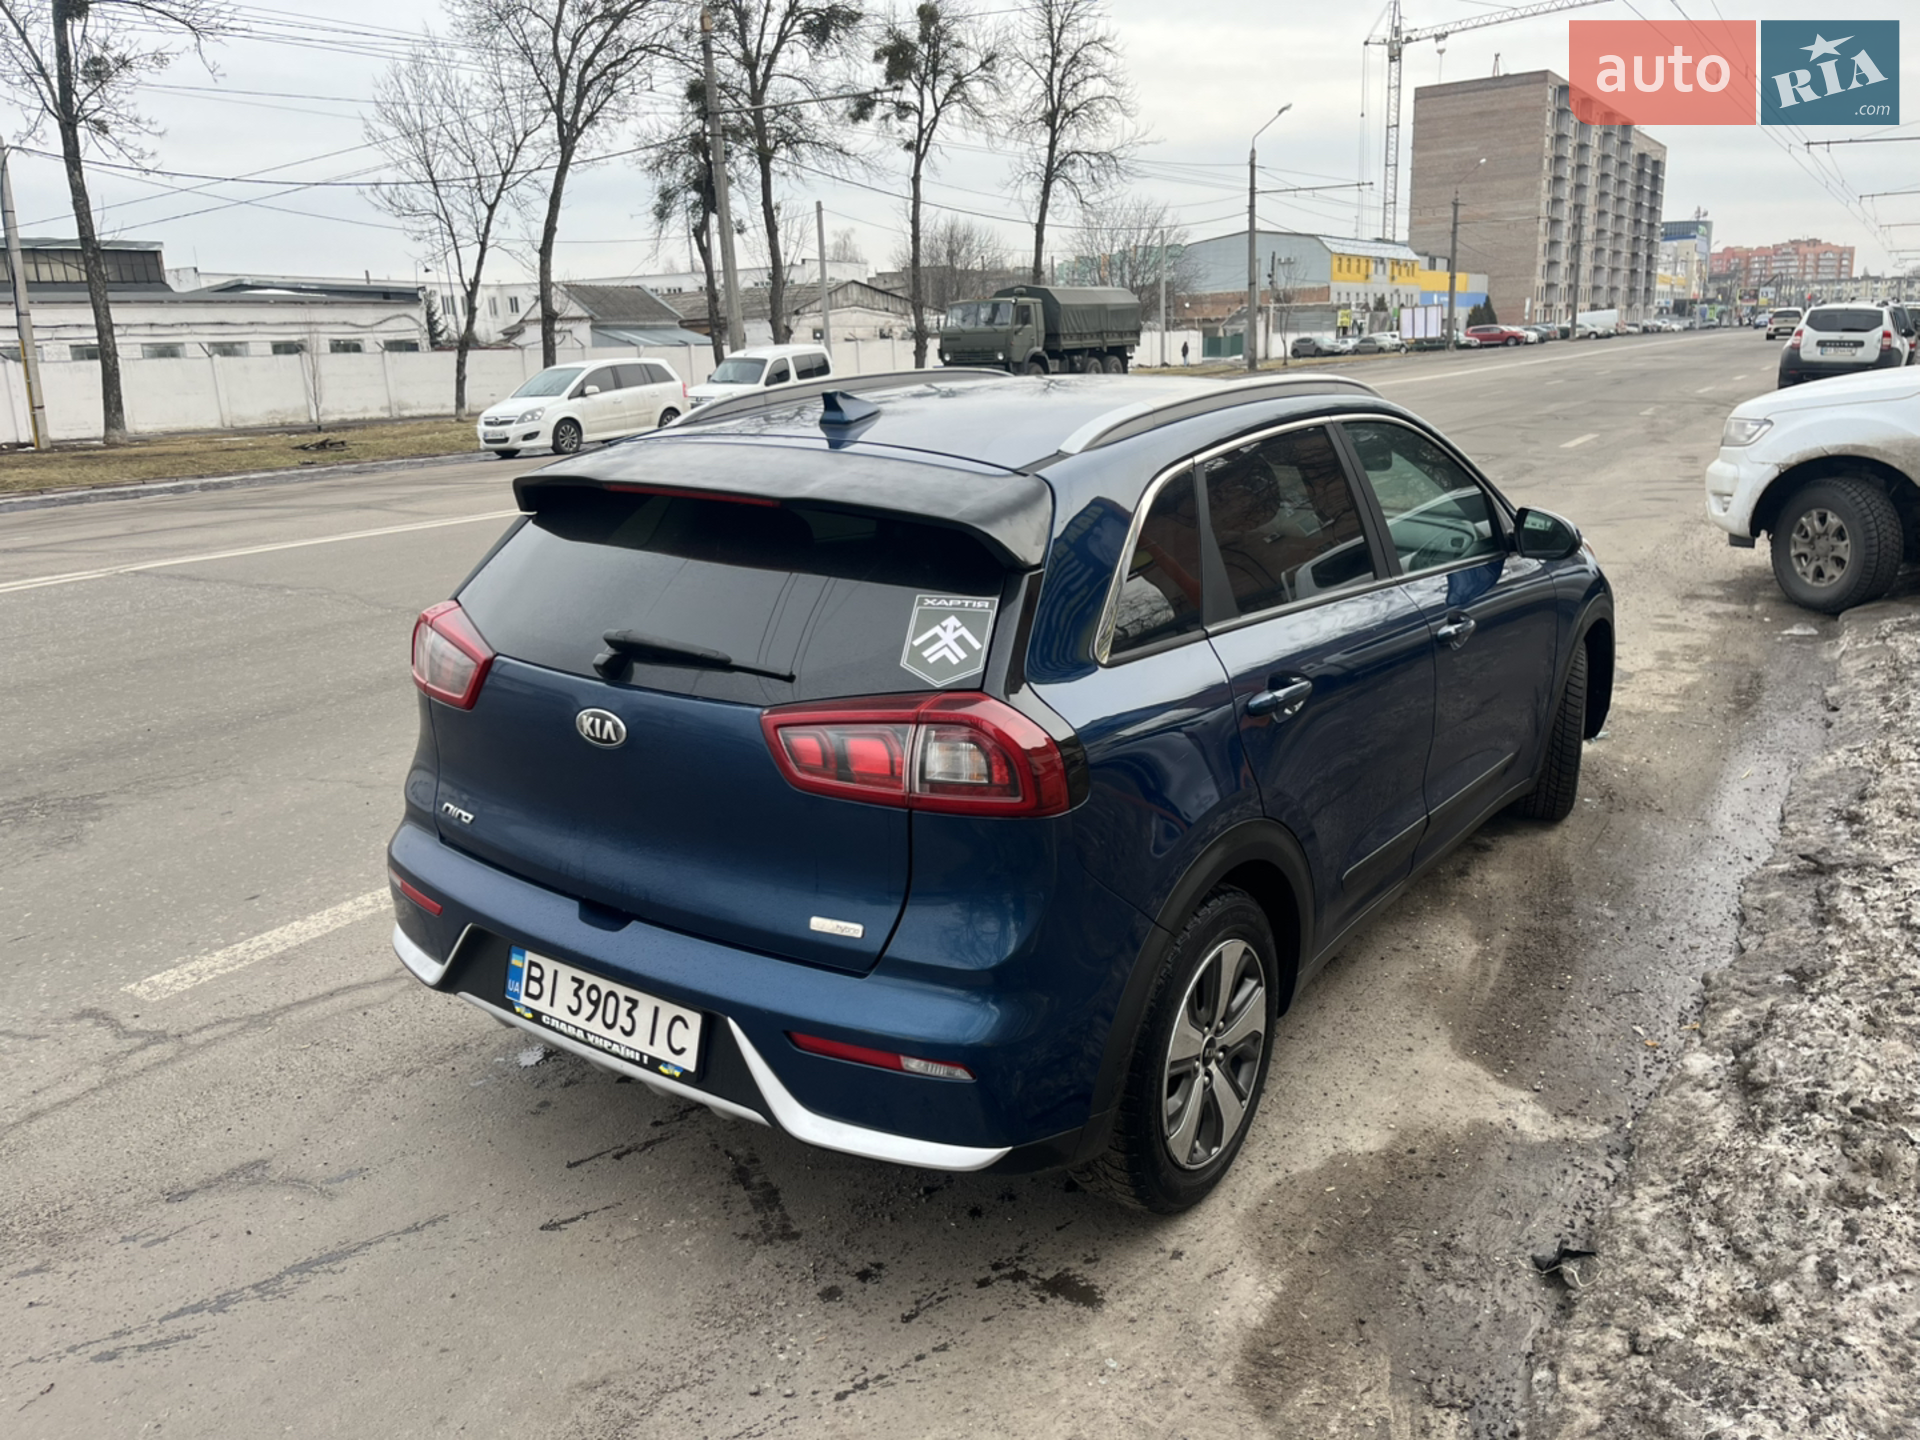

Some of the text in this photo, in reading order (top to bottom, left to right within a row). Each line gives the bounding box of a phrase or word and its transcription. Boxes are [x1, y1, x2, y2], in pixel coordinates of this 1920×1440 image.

[923, 598, 990, 609] ХАРТІЯ
[582, 714, 617, 741] KIA
[507, 978, 521, 995] UA
[524, 959, 690, 1056] BI 3903 IC
[540, 1014, 585, 1041] СЛАВА
